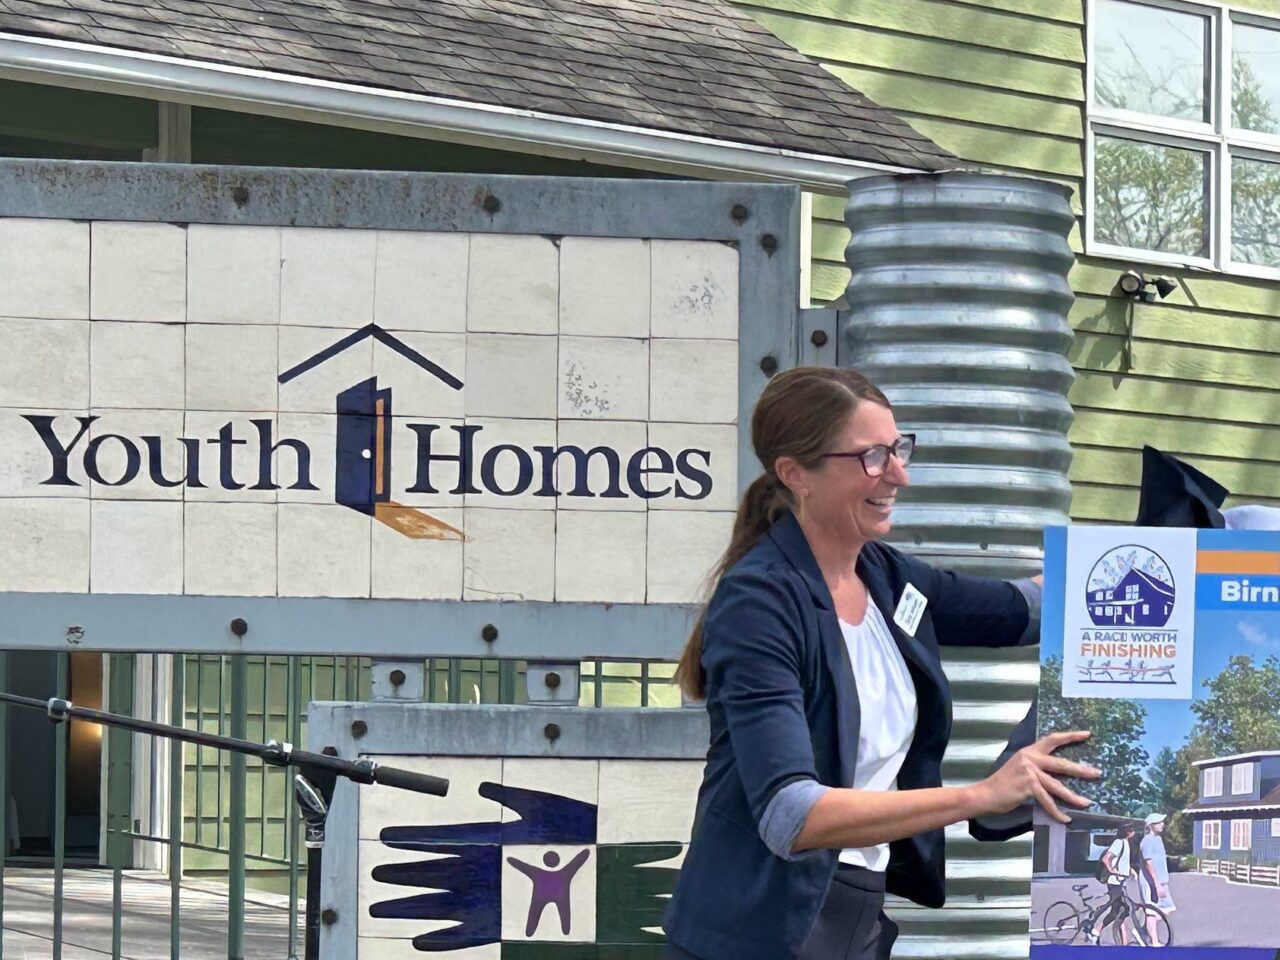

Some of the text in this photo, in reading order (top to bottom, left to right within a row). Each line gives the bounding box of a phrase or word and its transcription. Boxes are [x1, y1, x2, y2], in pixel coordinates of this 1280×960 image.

[20, 414, 714, 500] Youth Homes
[1081, 631, 1177, 644] A RACE WORTH
[1080, 643, 1177, 659] FINISHING
